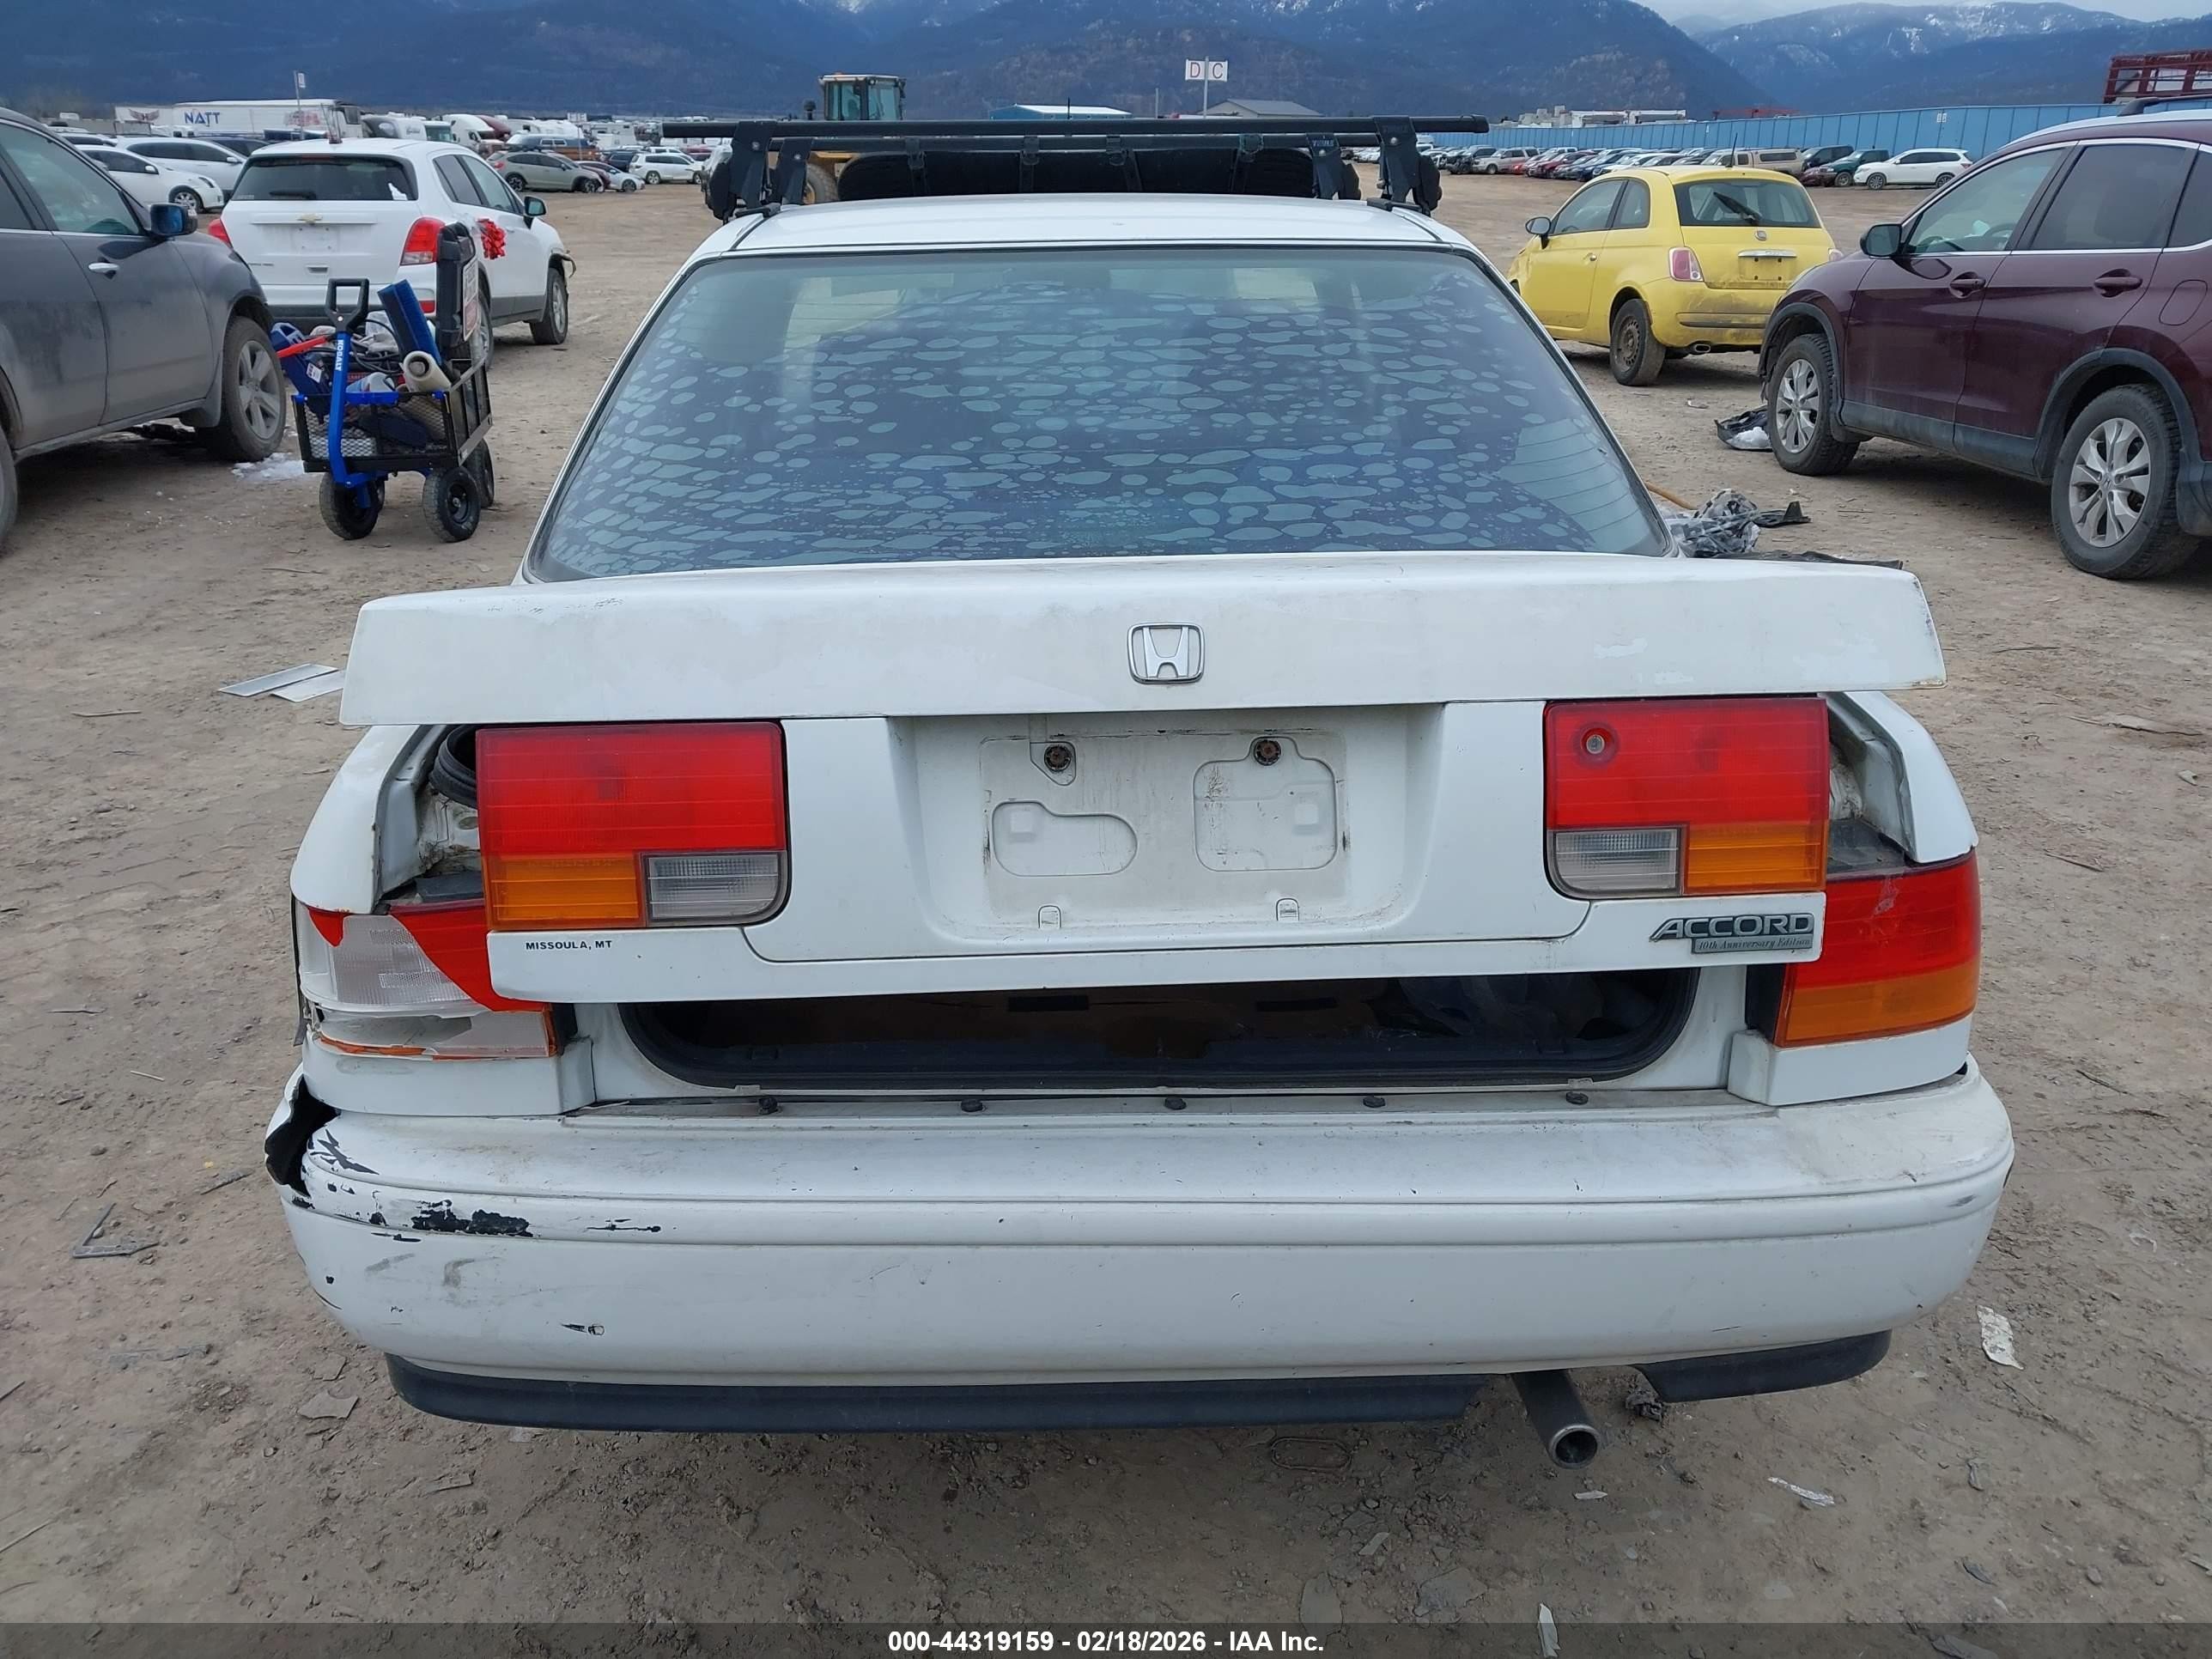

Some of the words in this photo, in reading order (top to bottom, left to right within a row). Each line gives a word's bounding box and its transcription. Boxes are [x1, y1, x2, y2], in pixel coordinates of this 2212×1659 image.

[1190, 62, 1200, 78] D
[1212, 63, 1224, 79] C
[185, 112, 221, 126] NATT
[336, 339, 344, 371] KOBALT
[1650, 913, 1815, 941] ACCORD
[526, 940, 591, 951] MISSOULA,
[595, 939, 612, 949] MT
[1698, 940, 1717, 951] 10th
[1718, 939, 1775, 951] Anniversary
[1777, 937, 1811, 947] Edition
